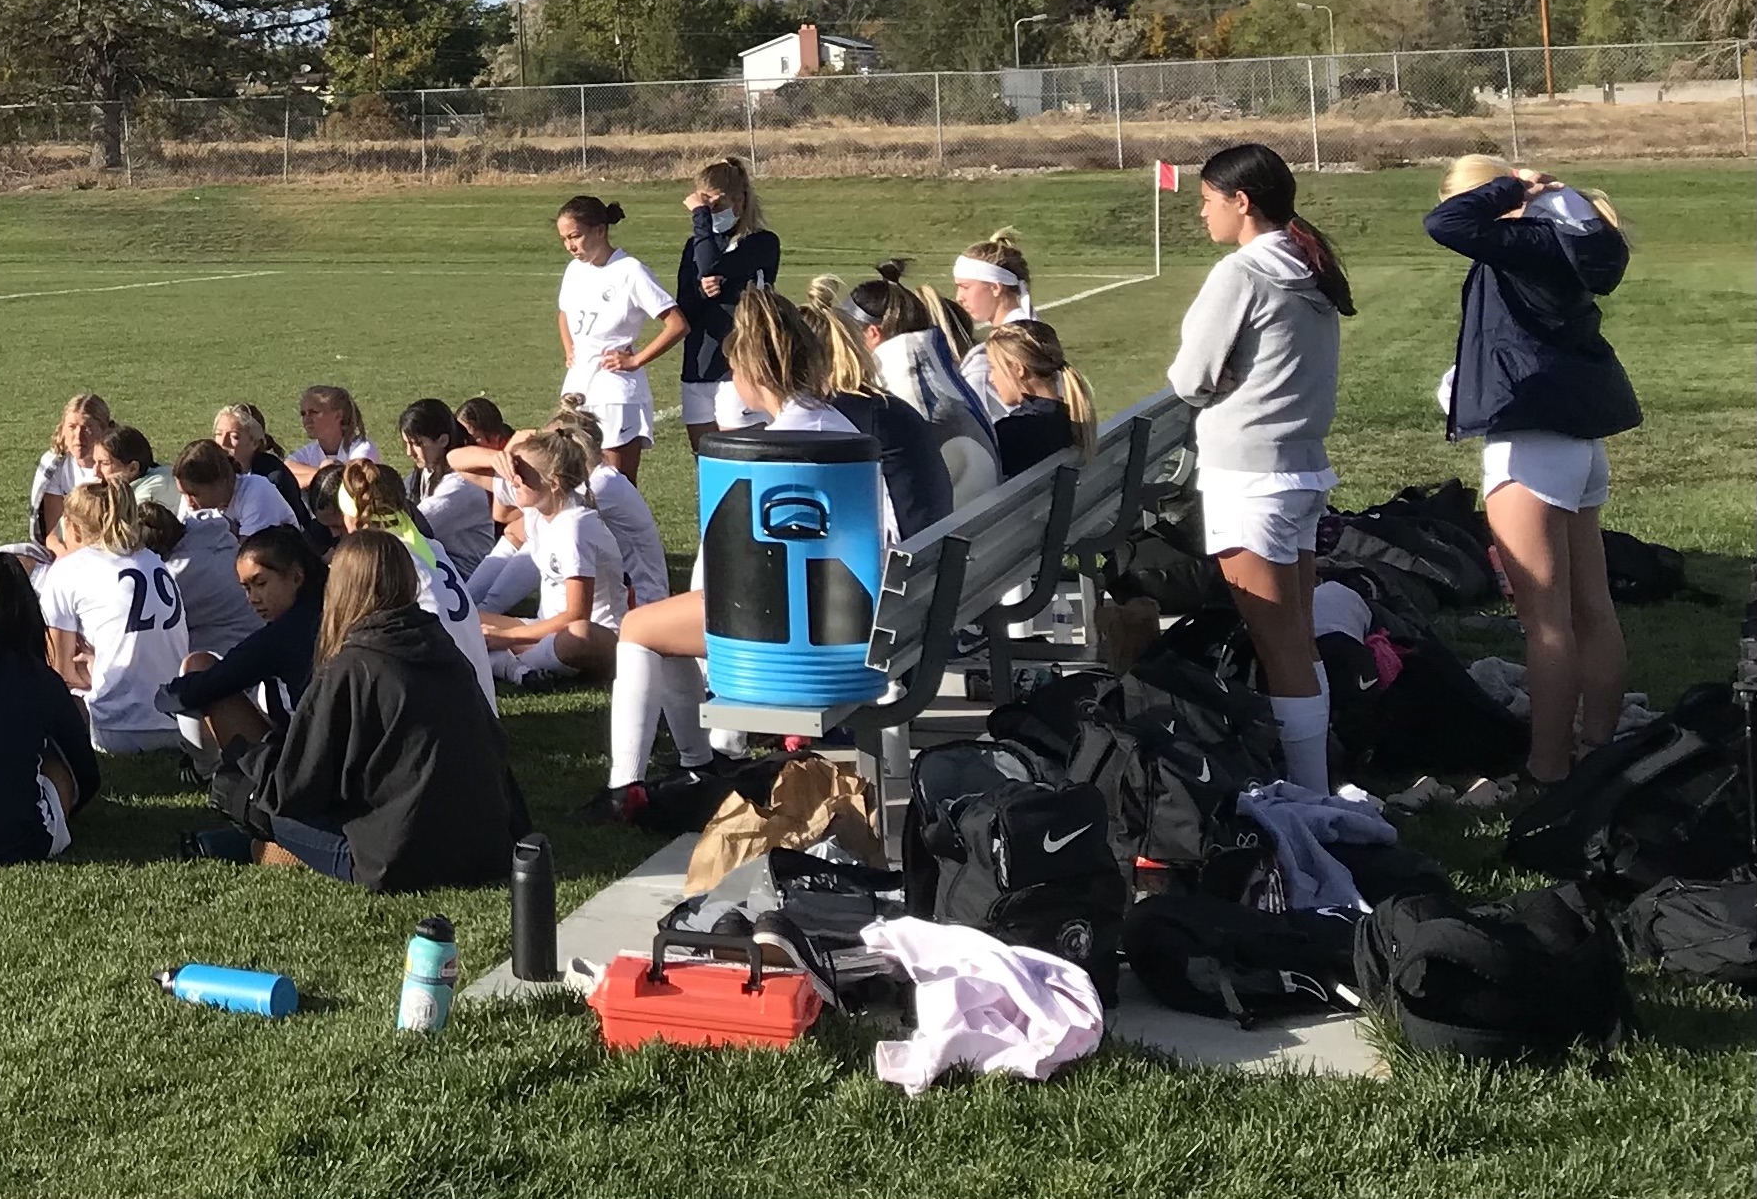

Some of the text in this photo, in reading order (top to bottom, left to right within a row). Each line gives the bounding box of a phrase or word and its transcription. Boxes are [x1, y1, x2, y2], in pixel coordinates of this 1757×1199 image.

[573, 309, 599, 336] 37
[117, 566, 182, 634] 29
[435, 560, 470, 622] 3
